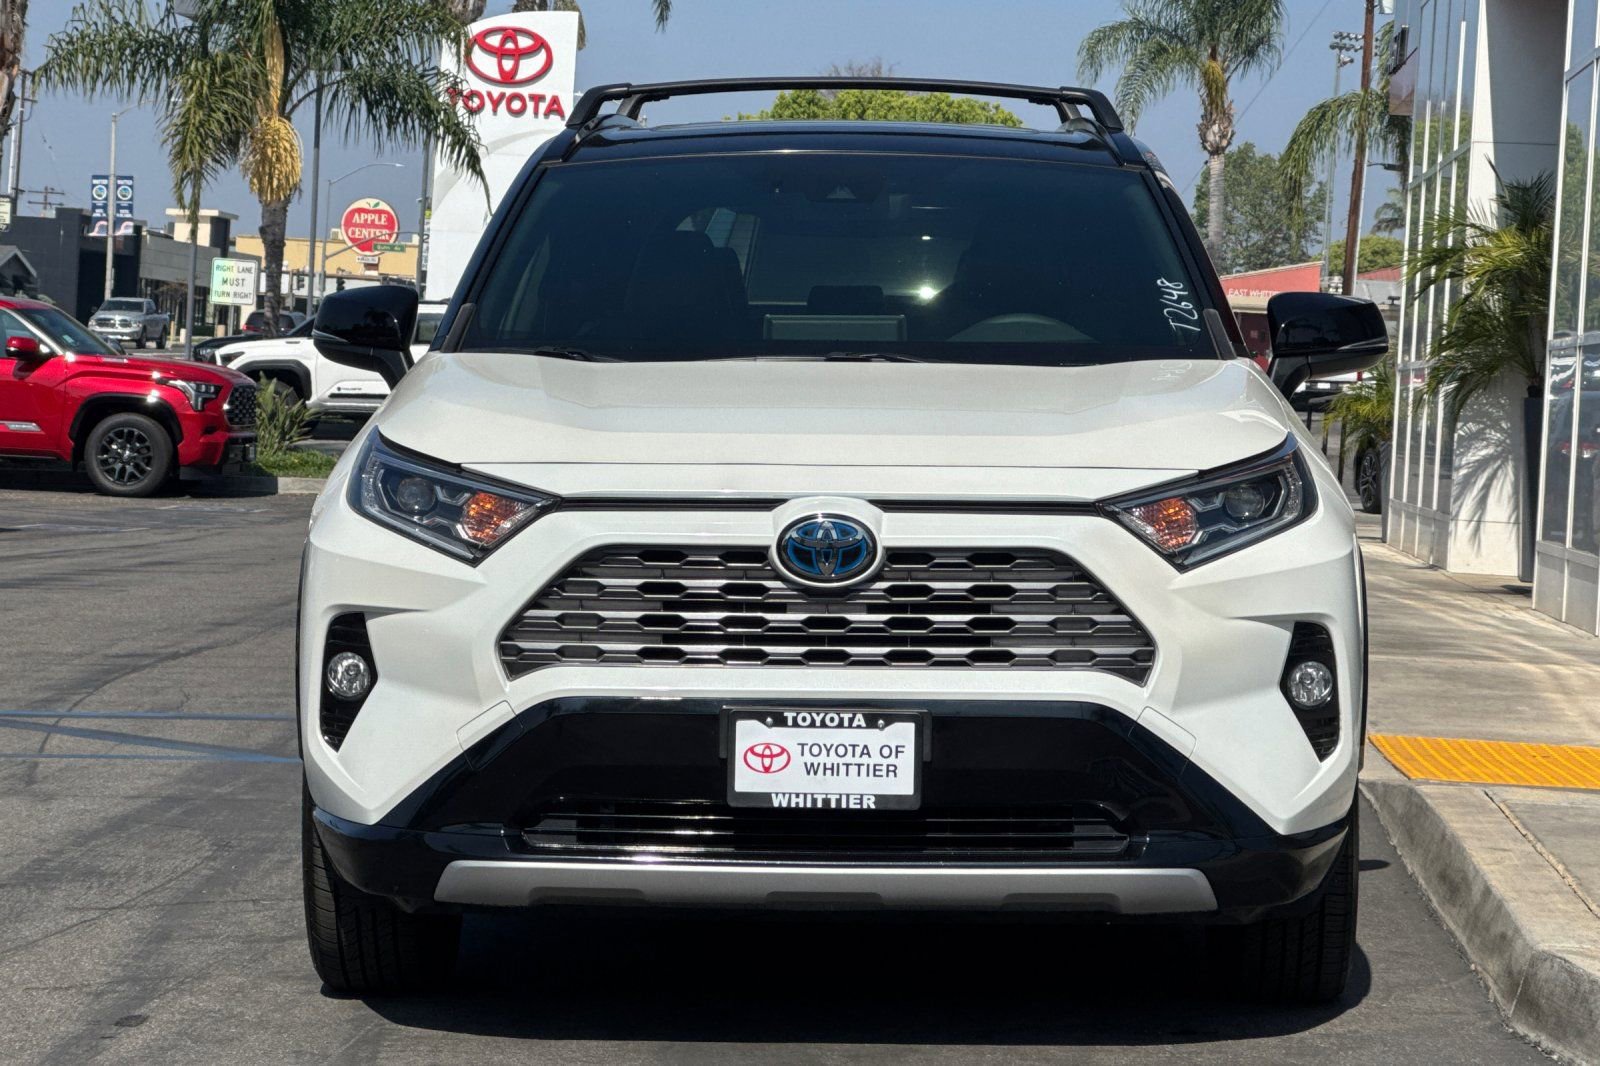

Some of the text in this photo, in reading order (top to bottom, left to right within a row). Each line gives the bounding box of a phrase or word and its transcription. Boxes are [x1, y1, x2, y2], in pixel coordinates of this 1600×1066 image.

[352, 212, 387, 225] APPLE
[348, 227, 389, 240] CENTER
[216, 264, 253, 274] RIGHT LANE
[222, 277, 246, 287] MUST
[214, 290, 252, 299] TURN RIGHT
[1228, 288, 1248, 297] EAST
[784, 712, 866, 727] TOYOTA
[797, 742, 906, 759] TOYOTA OF
[804, 762, 898, 778] WHITTIER
[771, 793, 876, 809] WHITTIER
